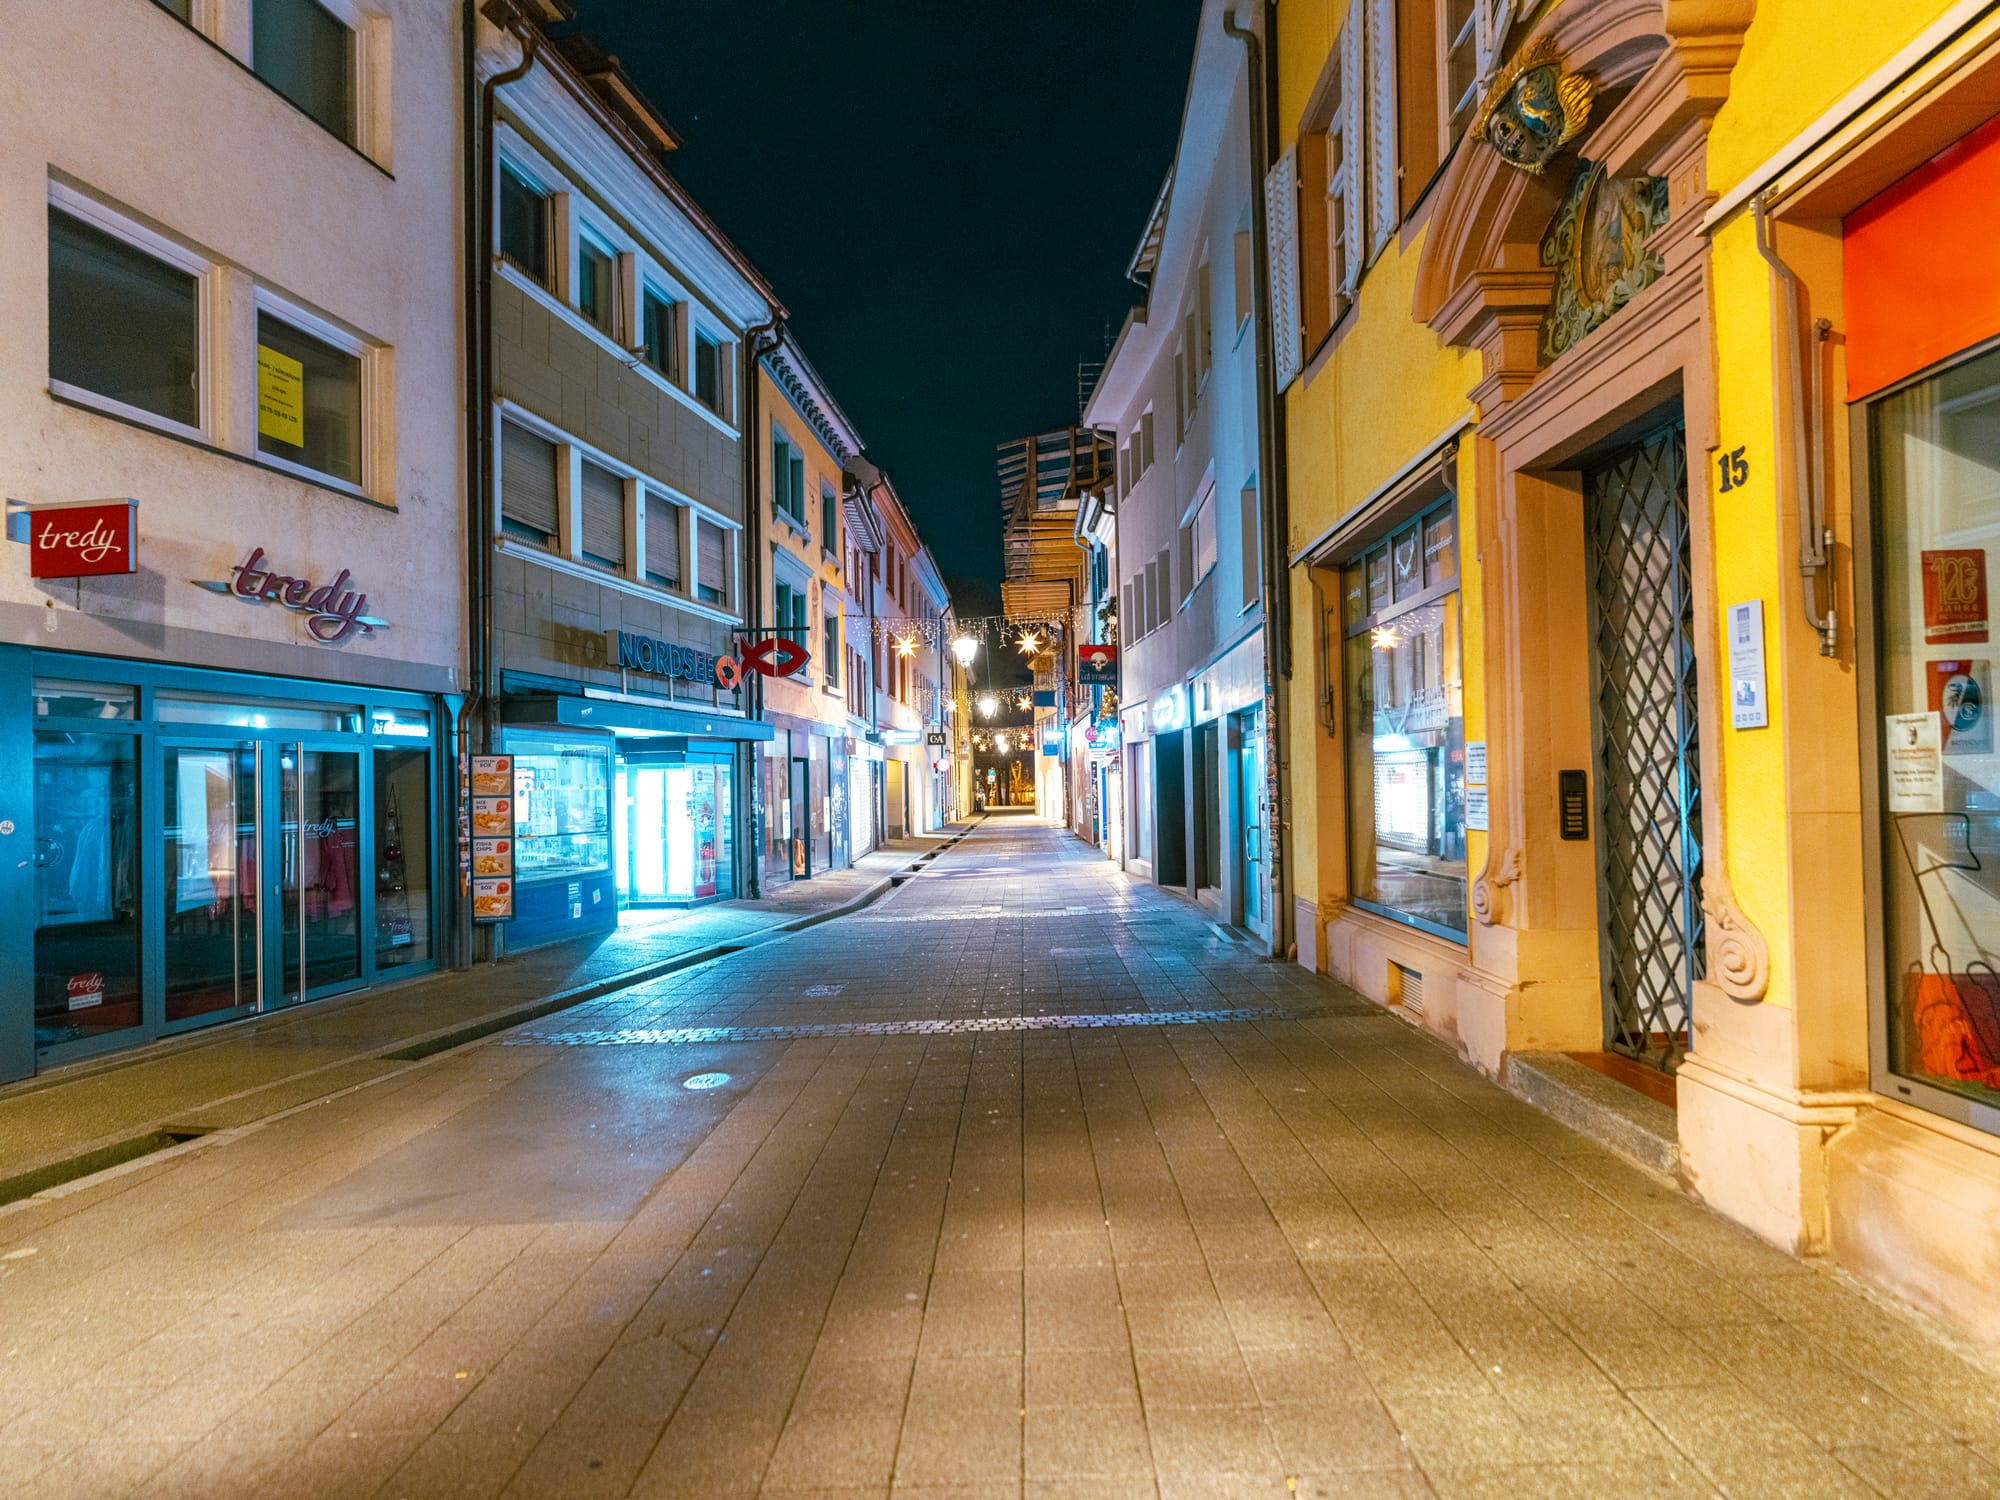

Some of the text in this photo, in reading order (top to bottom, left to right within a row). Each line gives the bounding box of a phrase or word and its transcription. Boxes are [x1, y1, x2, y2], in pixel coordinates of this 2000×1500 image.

[1718, 446, 1749, 493] 15
[37, 518, 122, 563] tredy
[229, 546, 375, 644] tredy
[616, 630, 715, 685] NORDSEE
[67, 973, 106, 993] tredy
